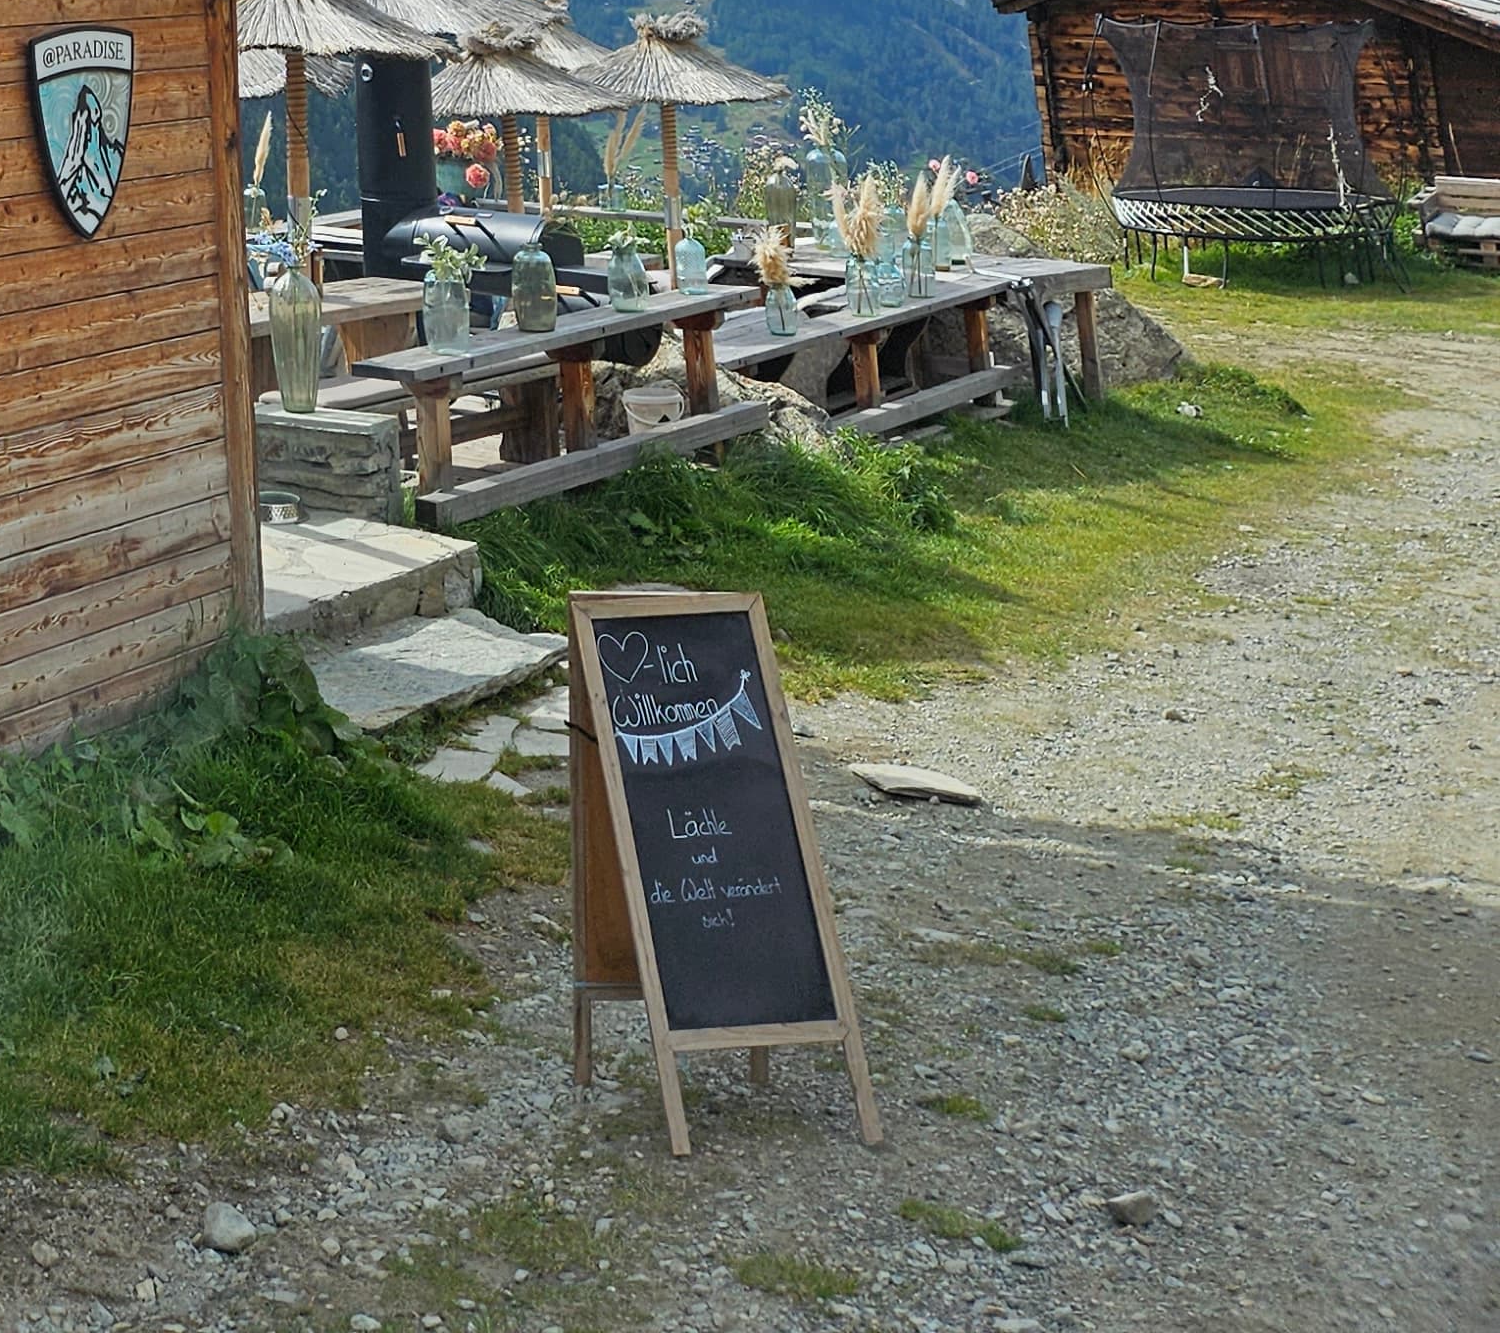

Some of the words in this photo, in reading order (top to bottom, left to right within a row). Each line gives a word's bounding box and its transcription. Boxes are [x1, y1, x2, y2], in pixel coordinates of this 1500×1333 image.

[612, 692, 719, 728] Willkommen
[667, 808, 732, 839] Lächle
[691, 845, 718, 864] und
[650, 878, 676, 904] die
[681, 878, 716, 902] Welt
[720, 876, 782, 898] verändert
[702, 908, 735, 928] sich!
